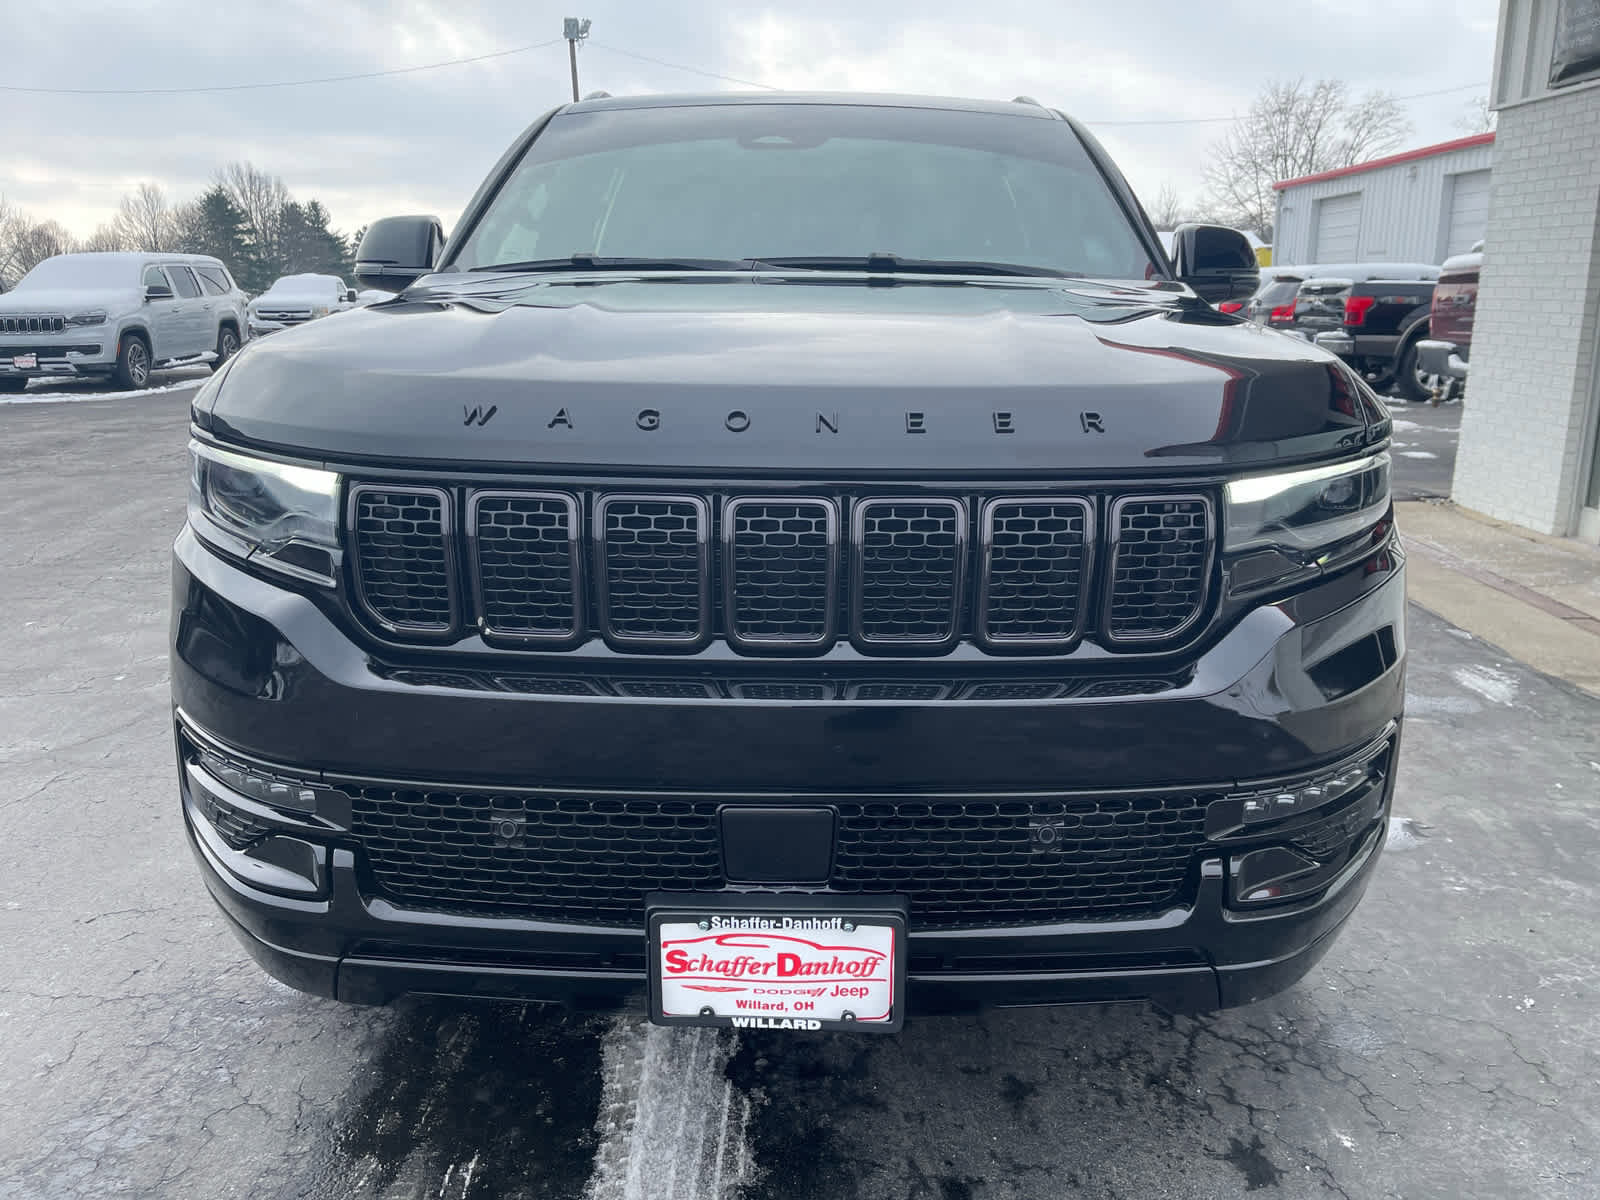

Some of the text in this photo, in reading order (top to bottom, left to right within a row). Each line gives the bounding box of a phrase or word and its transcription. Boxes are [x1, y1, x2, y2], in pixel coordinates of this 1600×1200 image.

[463, 404, 1105, 434] WAGONEER
[711, 916, 842, 932] Schaffer-Danhoff
[665, 950, 882, 977] Schaffer Danhoff
[830, 985, 869, 998] Jeep
[736, 1000, 814, 1012] Willard, OH
[732, 1017, 821, 1030] WILLARD
